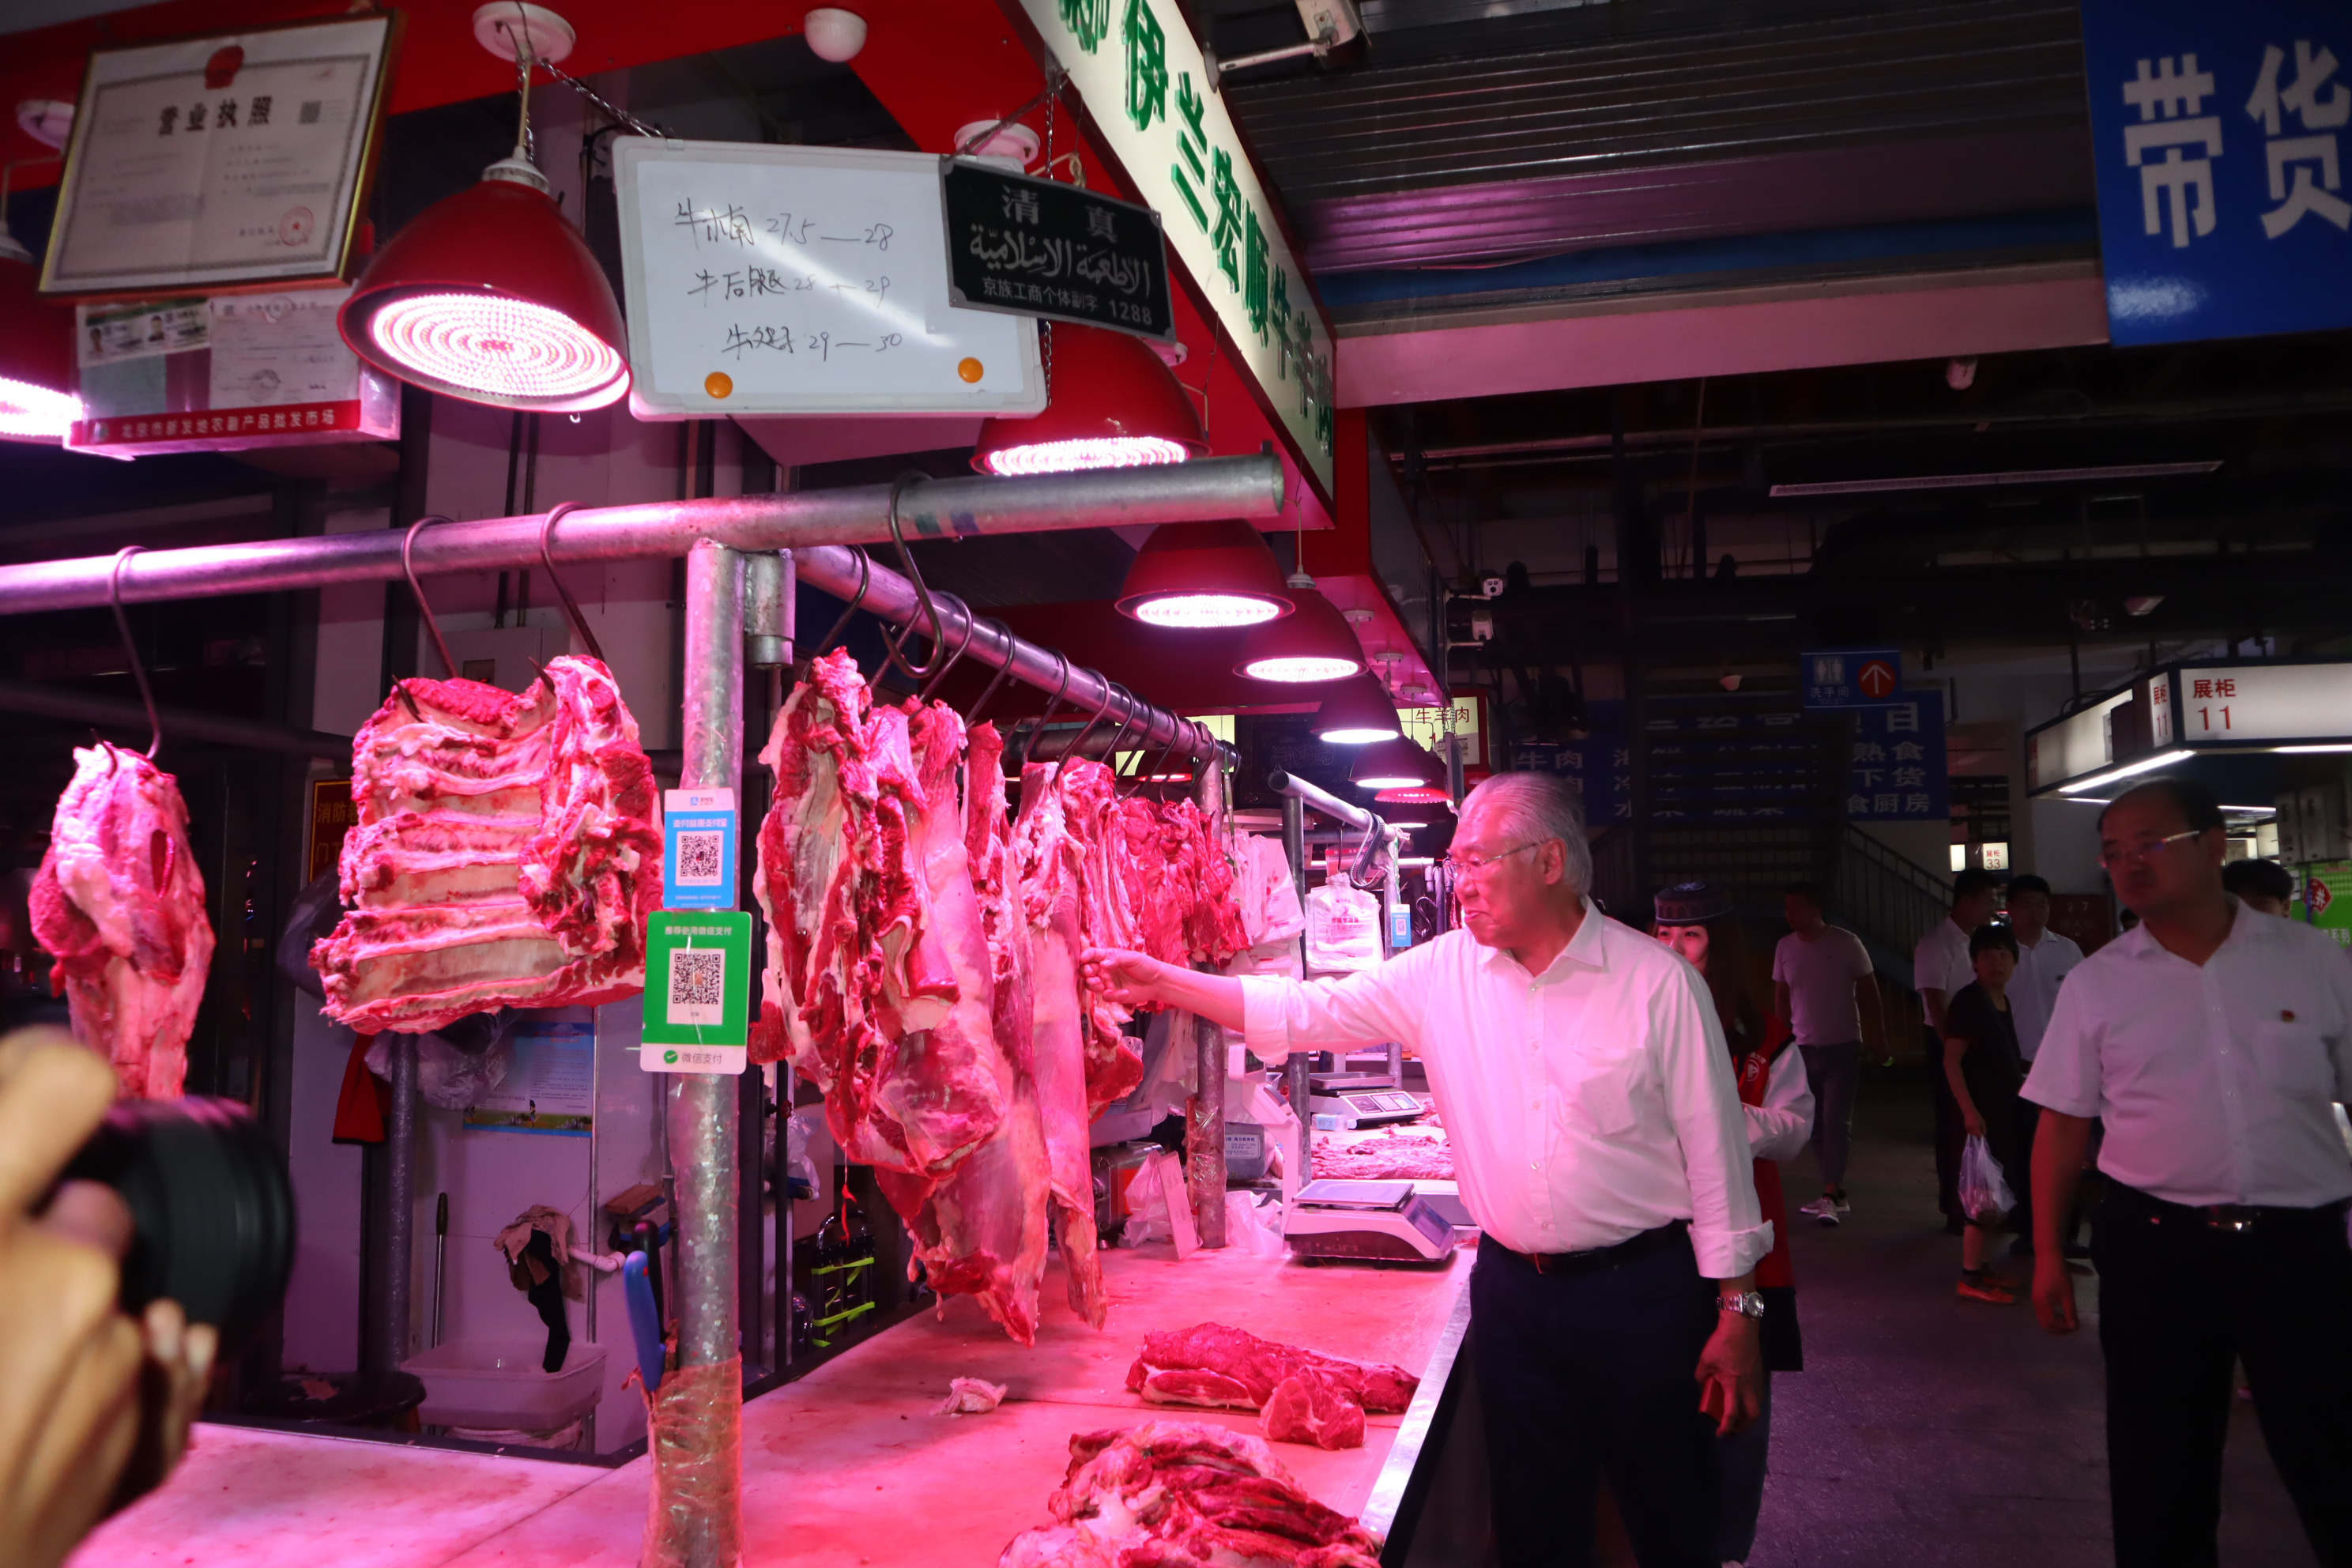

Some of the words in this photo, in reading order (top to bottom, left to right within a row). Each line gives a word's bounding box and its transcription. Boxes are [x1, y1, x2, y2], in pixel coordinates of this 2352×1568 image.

[159, 96, 272, 136] 营业执照
[1001, 184, 1118, 243] 清真
[1110, 300, 1152, 326] 1288
[1810, 686, 1850, 699] 洗手间
[2154, 684, 2167, 706] 展柜
[2192, 677, 2237, 699] 展柜
[1415, 706, 1470, 725] 牛羊肉
[2156, 712, 2168, 738] 11
[2198, 705, 2231, 731] 11
[1986, 858, 2001, 869] 33
[681, 1052, 722, 1065] 微信支付
